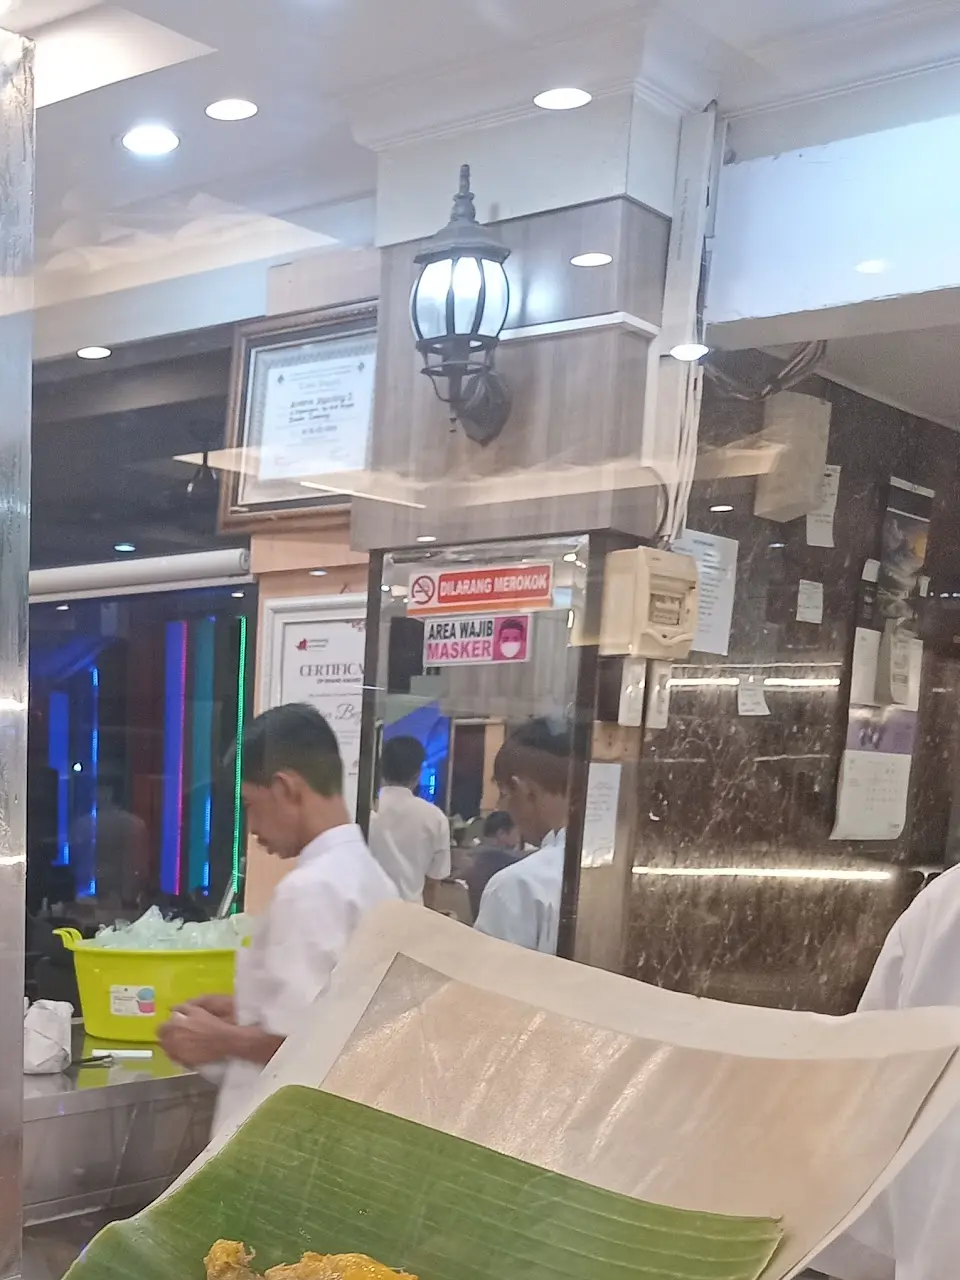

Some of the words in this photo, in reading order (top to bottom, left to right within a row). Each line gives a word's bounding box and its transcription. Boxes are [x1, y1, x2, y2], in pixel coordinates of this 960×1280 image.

[440, 577, 492, 597] DILARANG
[493, 572, 547, 592] MEROKOK
[428, 623, 456, 640] AREA
[460, 620, 493, 638] WAJIB
[426, 640, 491, 659] MASKER
